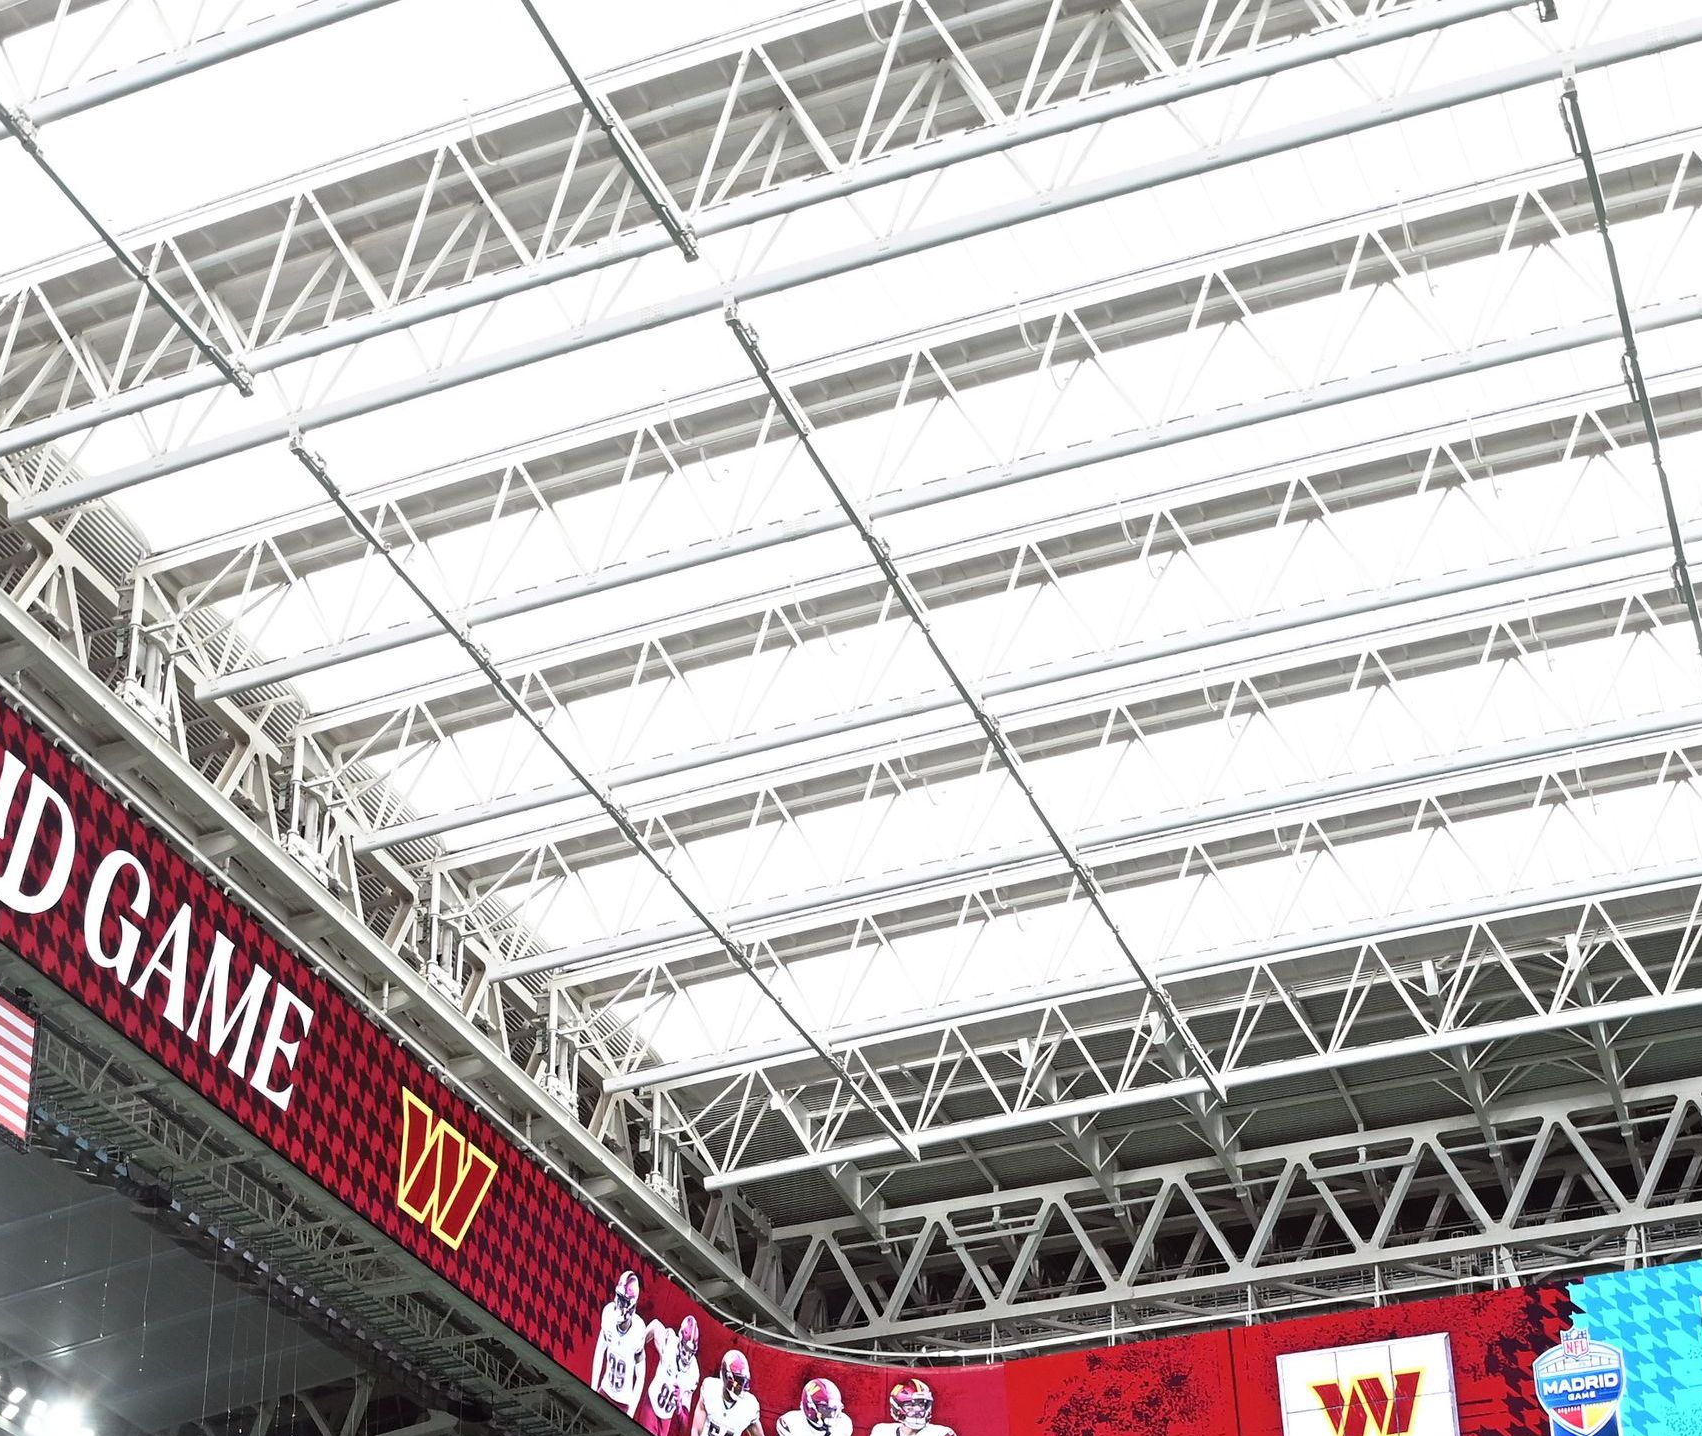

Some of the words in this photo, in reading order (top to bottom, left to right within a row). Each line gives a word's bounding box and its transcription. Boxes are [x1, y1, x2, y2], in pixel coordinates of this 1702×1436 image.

[83, 850, 314, 1111] GAME
[1566, 1340, 1587, 1354] NFL
[608, 1355, 625, 1392] 39
[1542, 1373, 1618, 1396] MADRID
[1568, 1391, 1596, 1401] GAME
